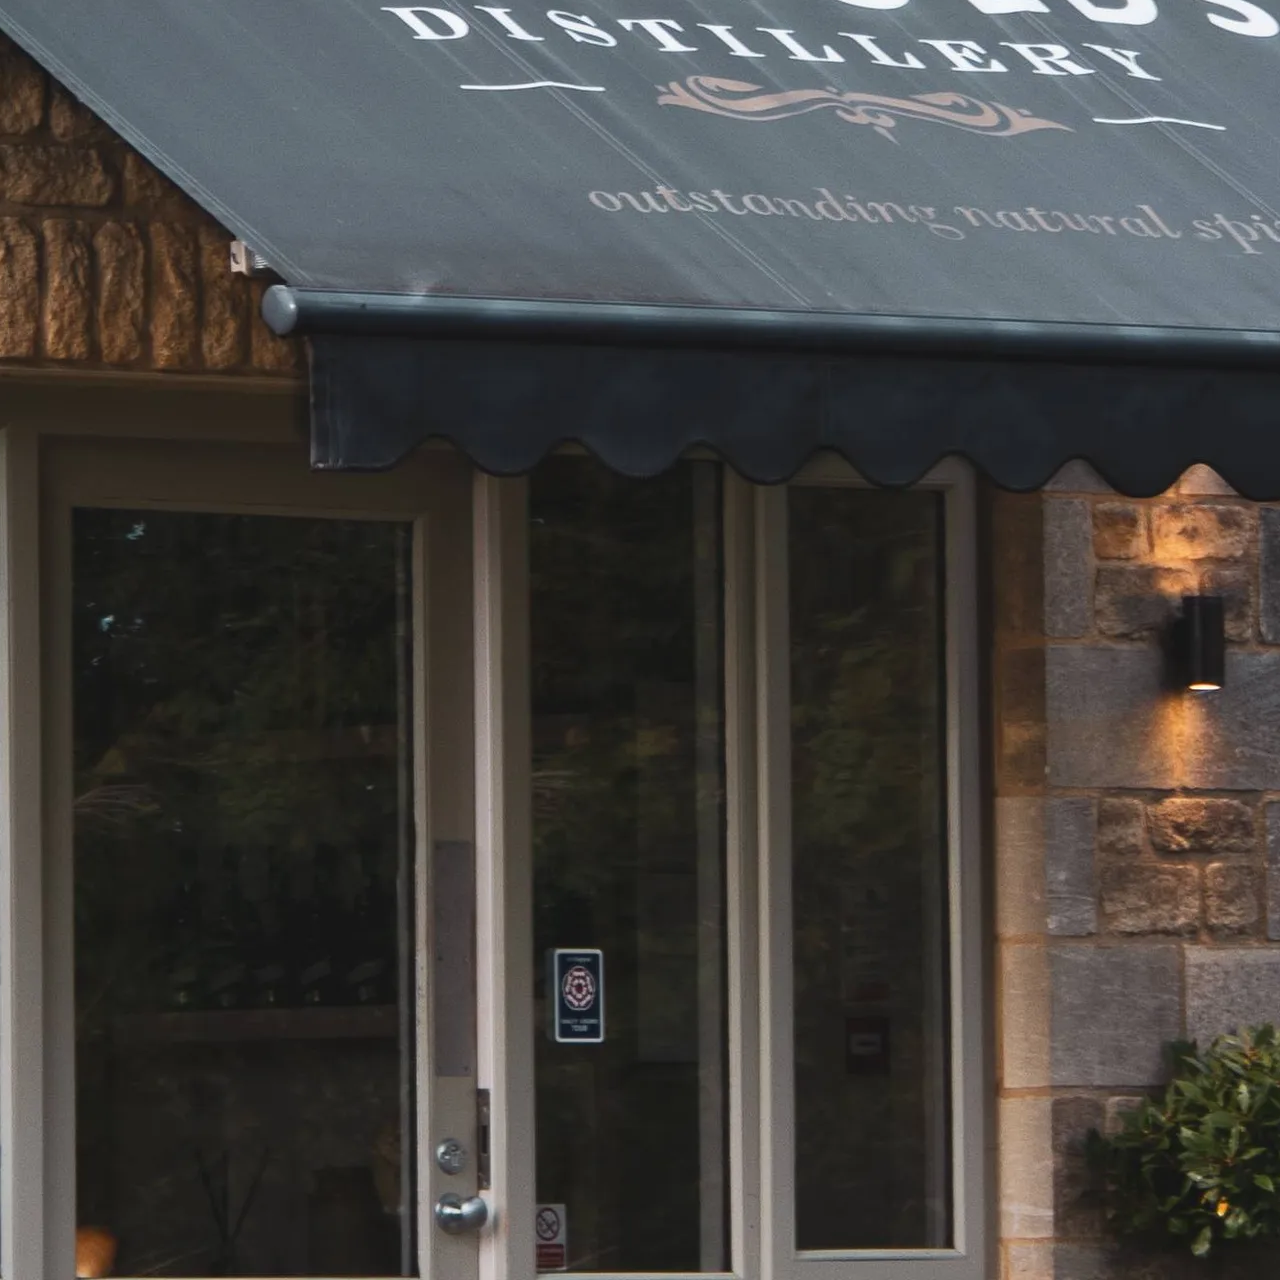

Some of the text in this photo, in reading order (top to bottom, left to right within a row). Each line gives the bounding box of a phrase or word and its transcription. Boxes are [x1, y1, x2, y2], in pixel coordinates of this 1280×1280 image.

[380, 6, 1162, 82] DISTILLERY
[588, 184, 966, 241] outstanding
[953, 204, 1182, 240] natural
